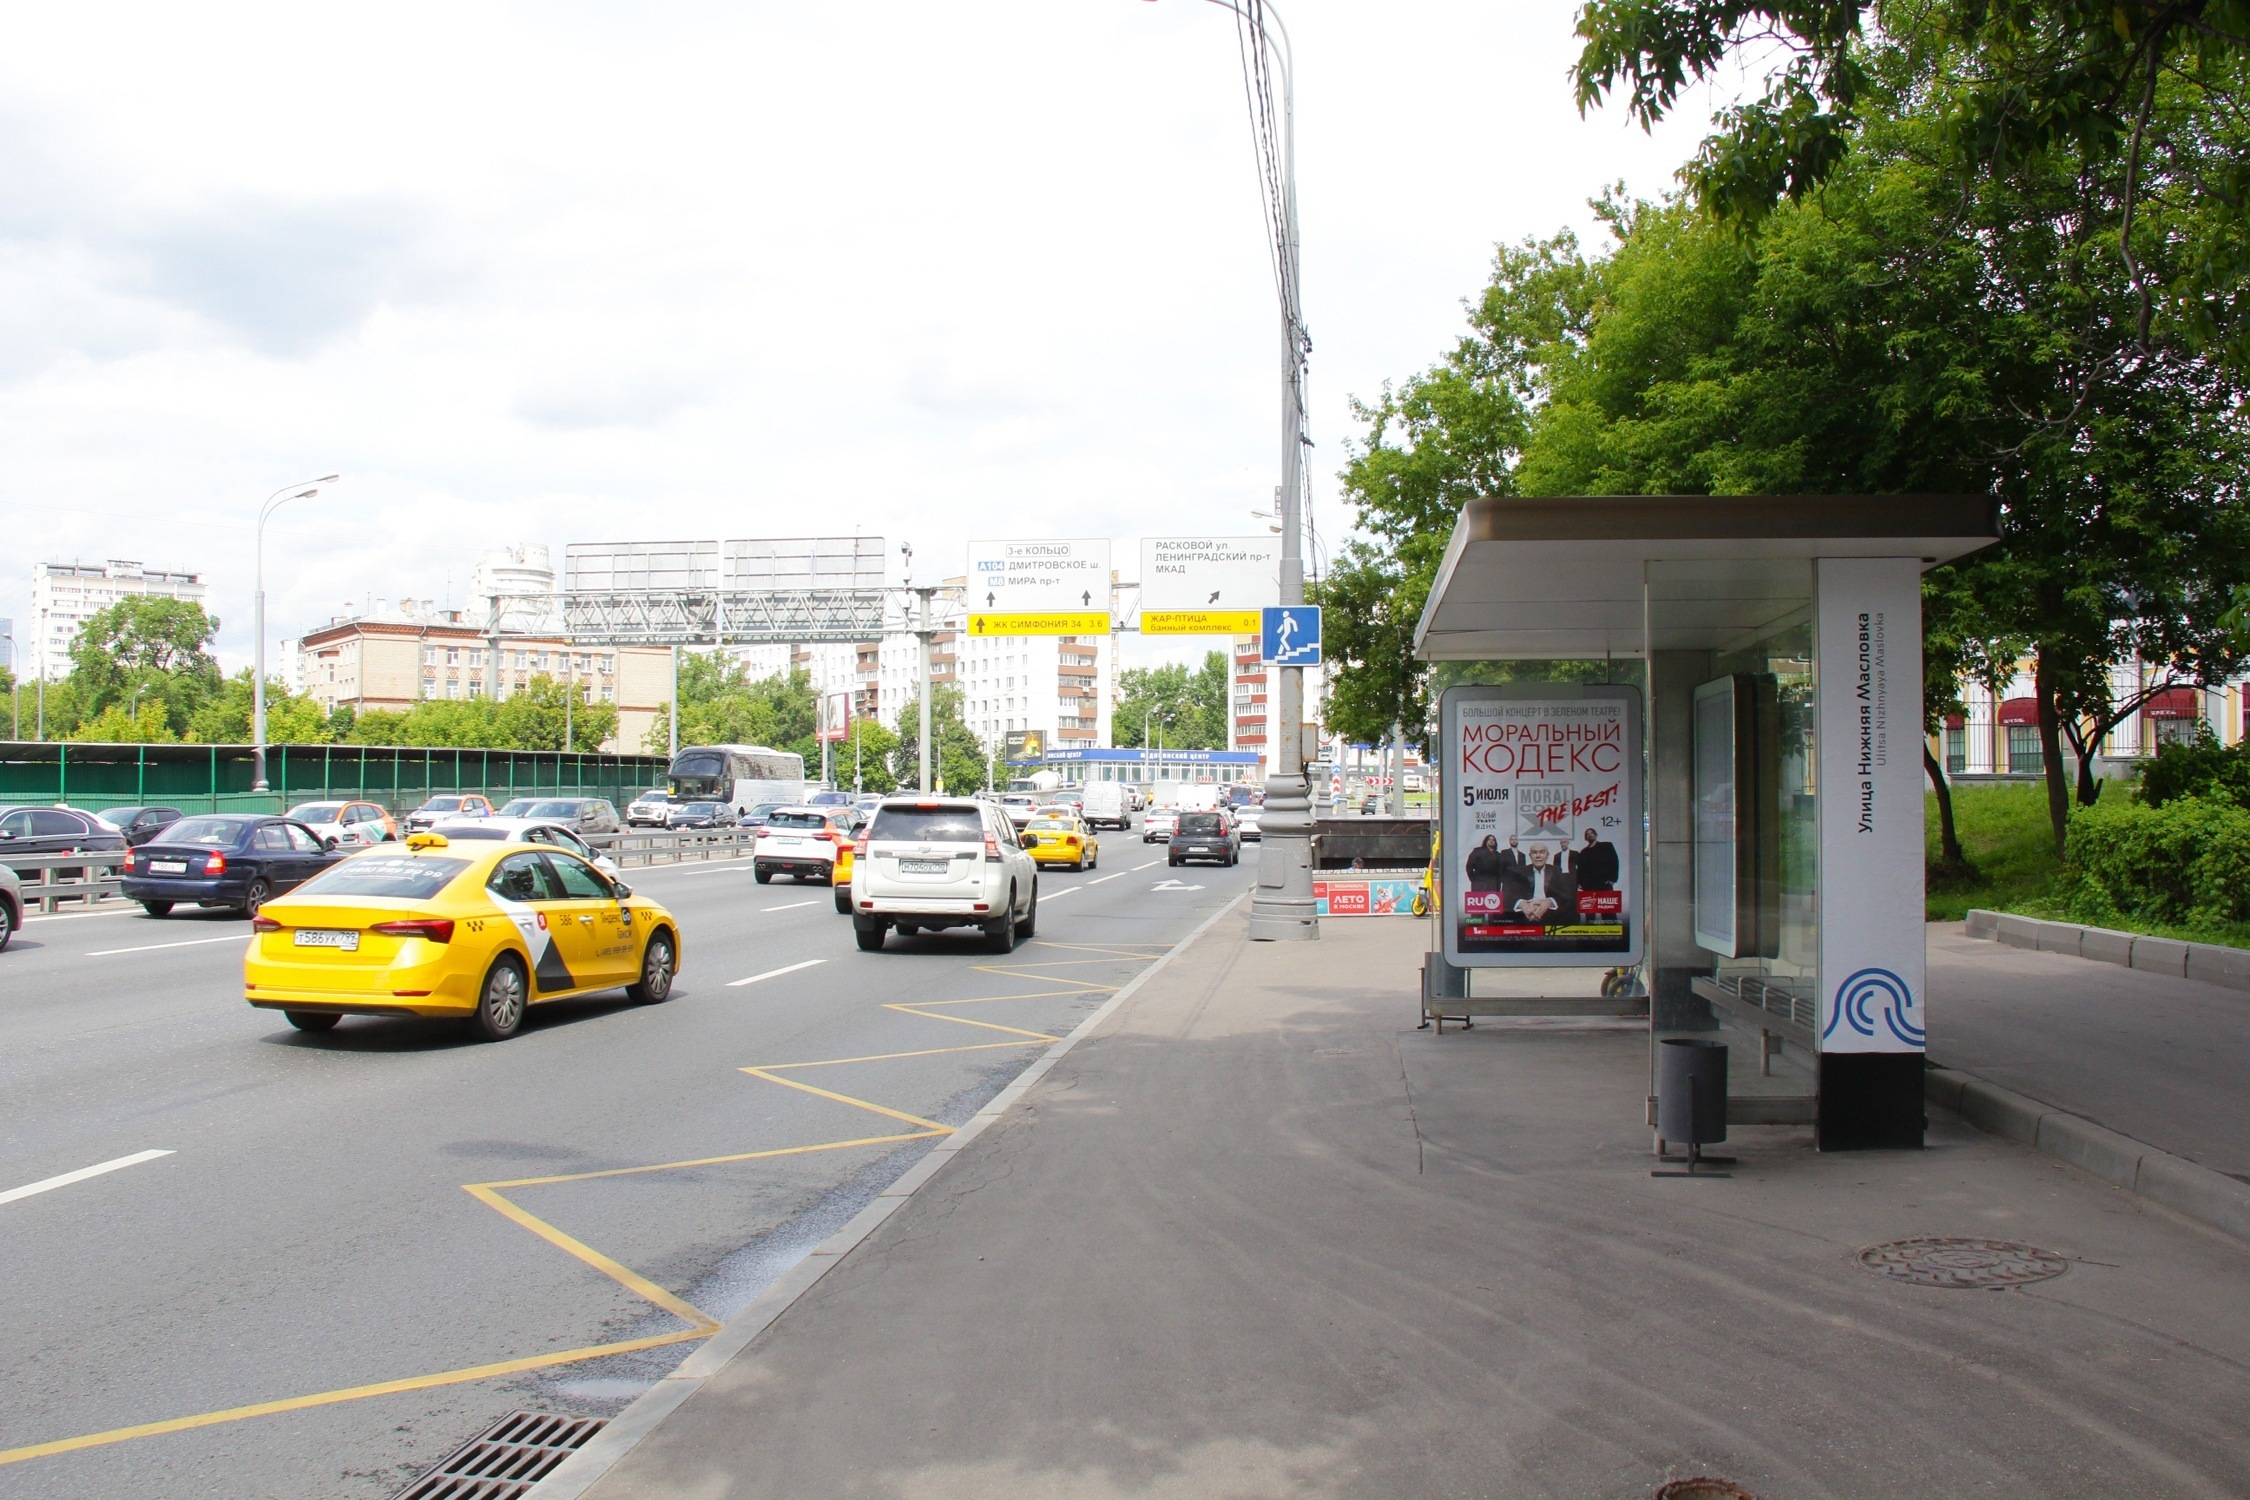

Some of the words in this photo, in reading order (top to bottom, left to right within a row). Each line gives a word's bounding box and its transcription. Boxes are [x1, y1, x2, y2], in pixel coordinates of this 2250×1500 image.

[1008, 547, 1023, 555] 3-е
[1025, 546, 1069, 556] КОЛЬЦО
[1156, 540, 1213, 550] РАСКОВОЙ
[1216, 543, 1231, 551] ул.
[1155, 551, 1247, 561] ЛЕНИНГРАДСКИЙ
[1250, 553, 1271, 561] пр-т
[1008, 560, 1087, 571] ДМИТРОВСКОЕ
[1155, 565, 1186, 575] МКАД
[1008, 577, 1037, 585] МИРА
[1040, 578, 1061, 587] пр-т
[993, 620, 1008, 629] ЖК
[1011, 619, 1068, 629] СИМФОНИЯ
[1071, 619, 1082, 628] 34
[1089, 619, 1103, 628] 3.6
[1151, 615, 1207, 624] ЖАР-ПТИЦА
[1244, 619, 1256, 627] 0.1
[1150, 624, 1186, 632] банный
[1189, 624, 1232, 632] комплекс
[1874, 612, 1885, 668] Maslovka
[1856, 613, 1871, 701] Масловка
[1876, 670, 1887, 727] Nizhnyaya
[1463, 705, 1503, 718] БОЛЬШОЙ
[1505, 706, 1541, 719] КОНЦЕРТ
[1543, 706, 1549, 717] В
[1551, 706, 1589, 716] ЗЕЛЕНОМ
[1591, 706, 1621, 716] ТЕАТРЕ!
[1463, 718, 1621, 743] МОРАЛЬНЫЙ
[1858, 705, 1872, 776] Нижняя
[1876, 732, 1887, 766] Ulitsa
[1140, 752, 1188, 760] МДИИНСКИЙ
[1463, 743, 1621, 780] КОДЕКС
[1463, 786, 1475, 807] 5
[1476, 788, 1509, 800] ИЮЛЯ
[1520, 788, 1571, 804] MORAL
[1536, 803, 1568, 828] THE
[1572, 783, 1619, 816] BEST!
[1857, 781, 1874, 834] Улица
[1600, 816, 1622, 827] 12+
[1334, 895, 1365, 904] ЛЕТО
[1467, 897, 1484, 906] RU
[1597, 897, 1619, 905] НАШЕ
[559, 914, 573, 926] 586
